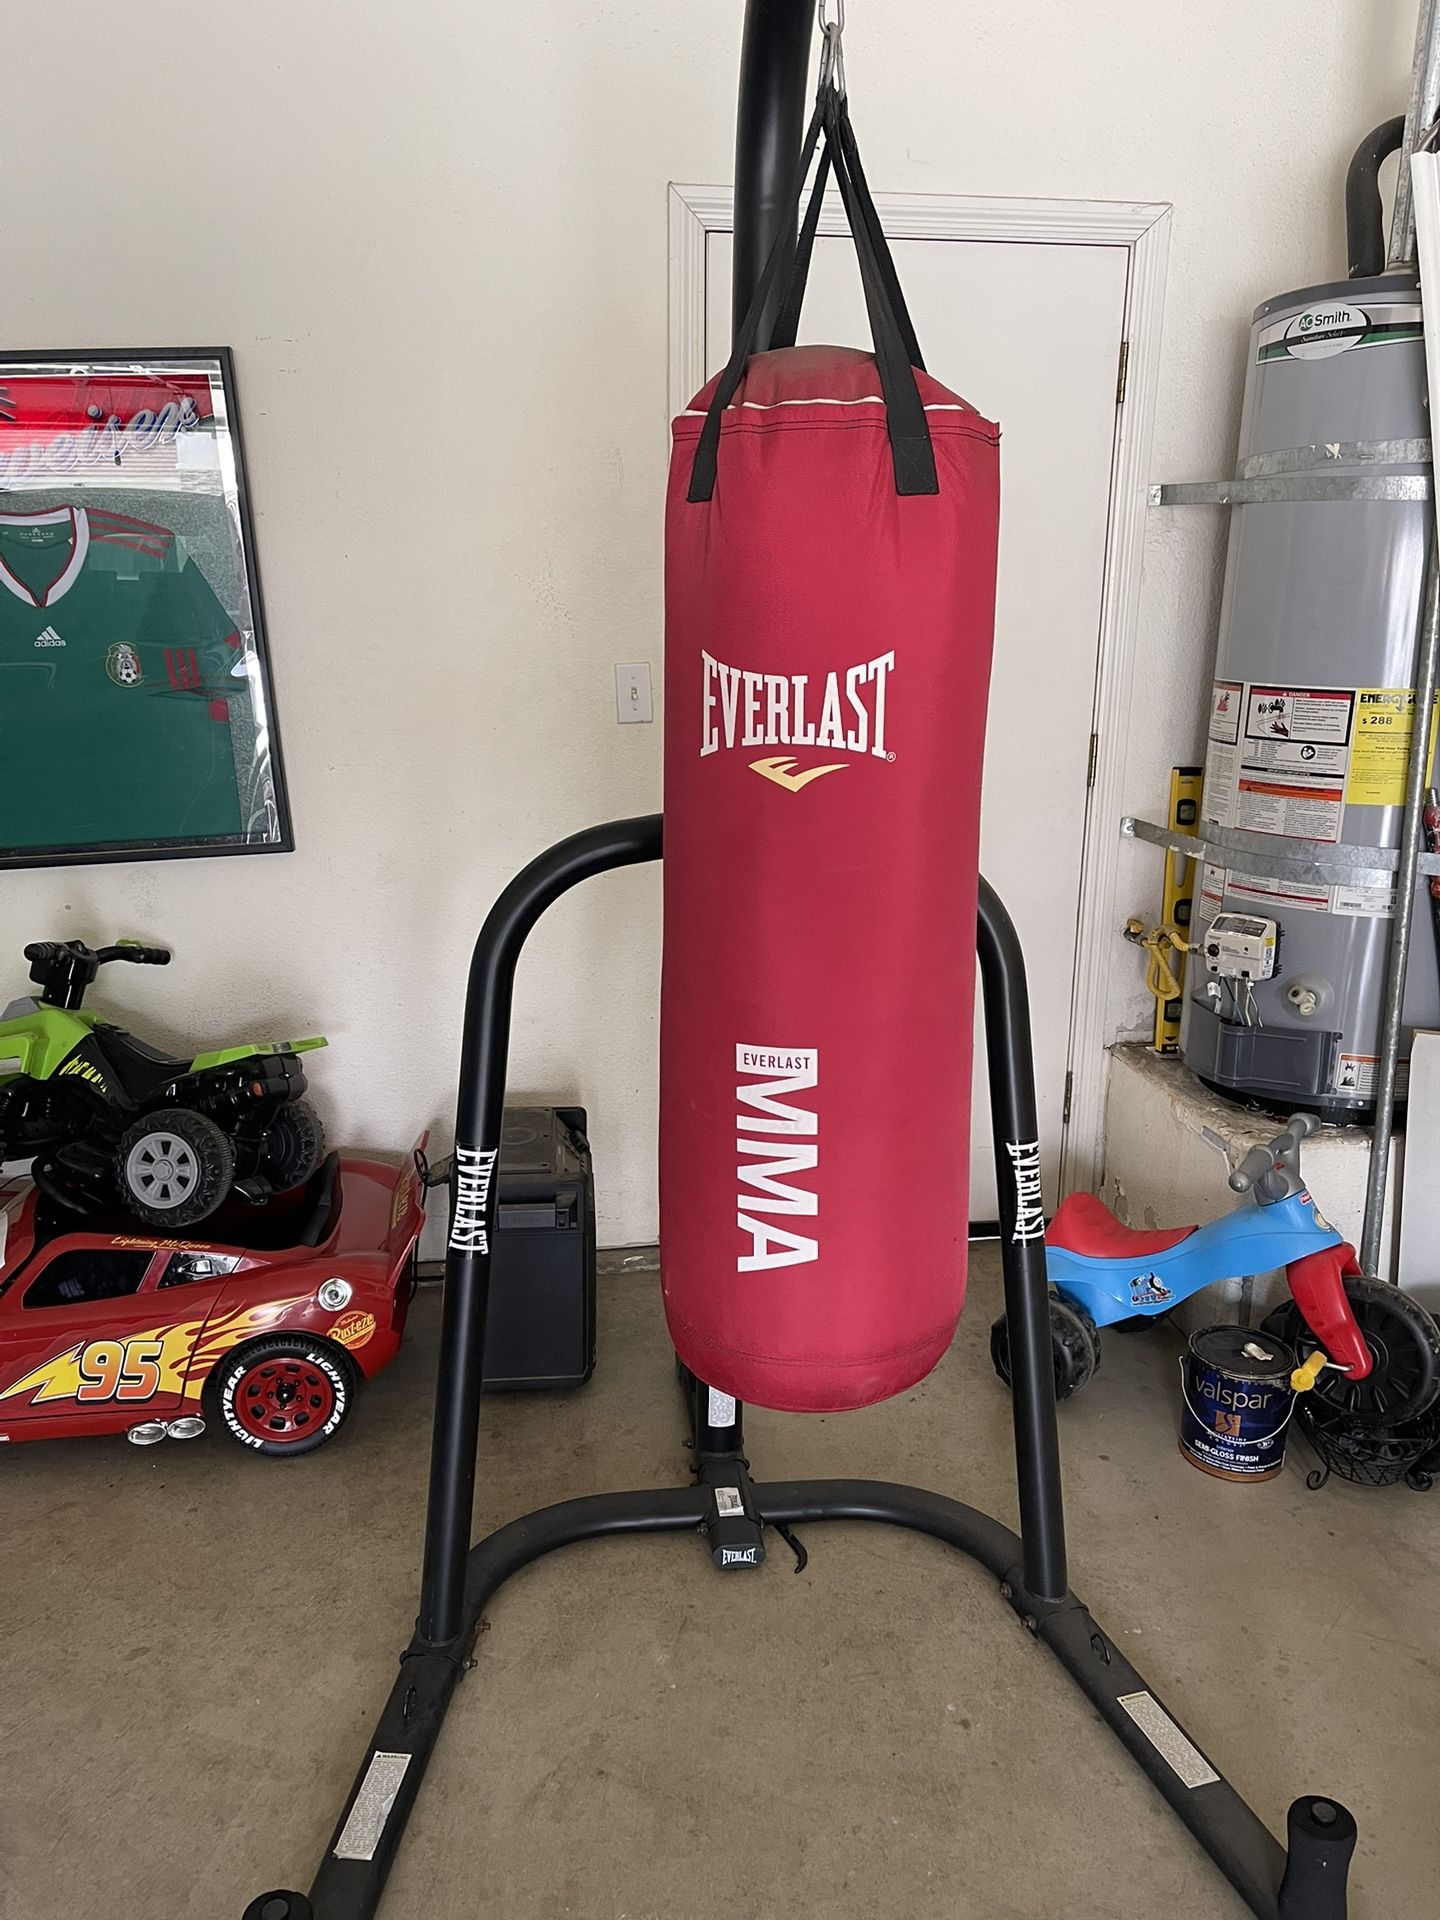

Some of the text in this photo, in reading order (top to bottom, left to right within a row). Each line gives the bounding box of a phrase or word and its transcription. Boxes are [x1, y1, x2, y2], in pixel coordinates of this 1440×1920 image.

[1315, 311, 1350, 326] Smith
[34, 640, 67, 648] adidas
[700, 648, 895, 760] EVERLAST
[1370, 716, 1393, 725] 288
[743, 1052, 811, 1070] EVERLAST
[736, 1043, 819, 1273] MMA
[448, 1145, 498, 1255] EVERLAST
[1005, 1140, 1045, 1240] EVERLAST
[77, 1340, 163, 1404] 95
[306, 1353, 345, 1434] LIGHTYEAR
[1195, 1375, 1272, 1411] valspar
[222, 1365, 264, 1449] LIGHTYEAR
[1236, 1454, 1259, 1462] FINISH
[722, 1547, 757, 1565] EVERLAST
